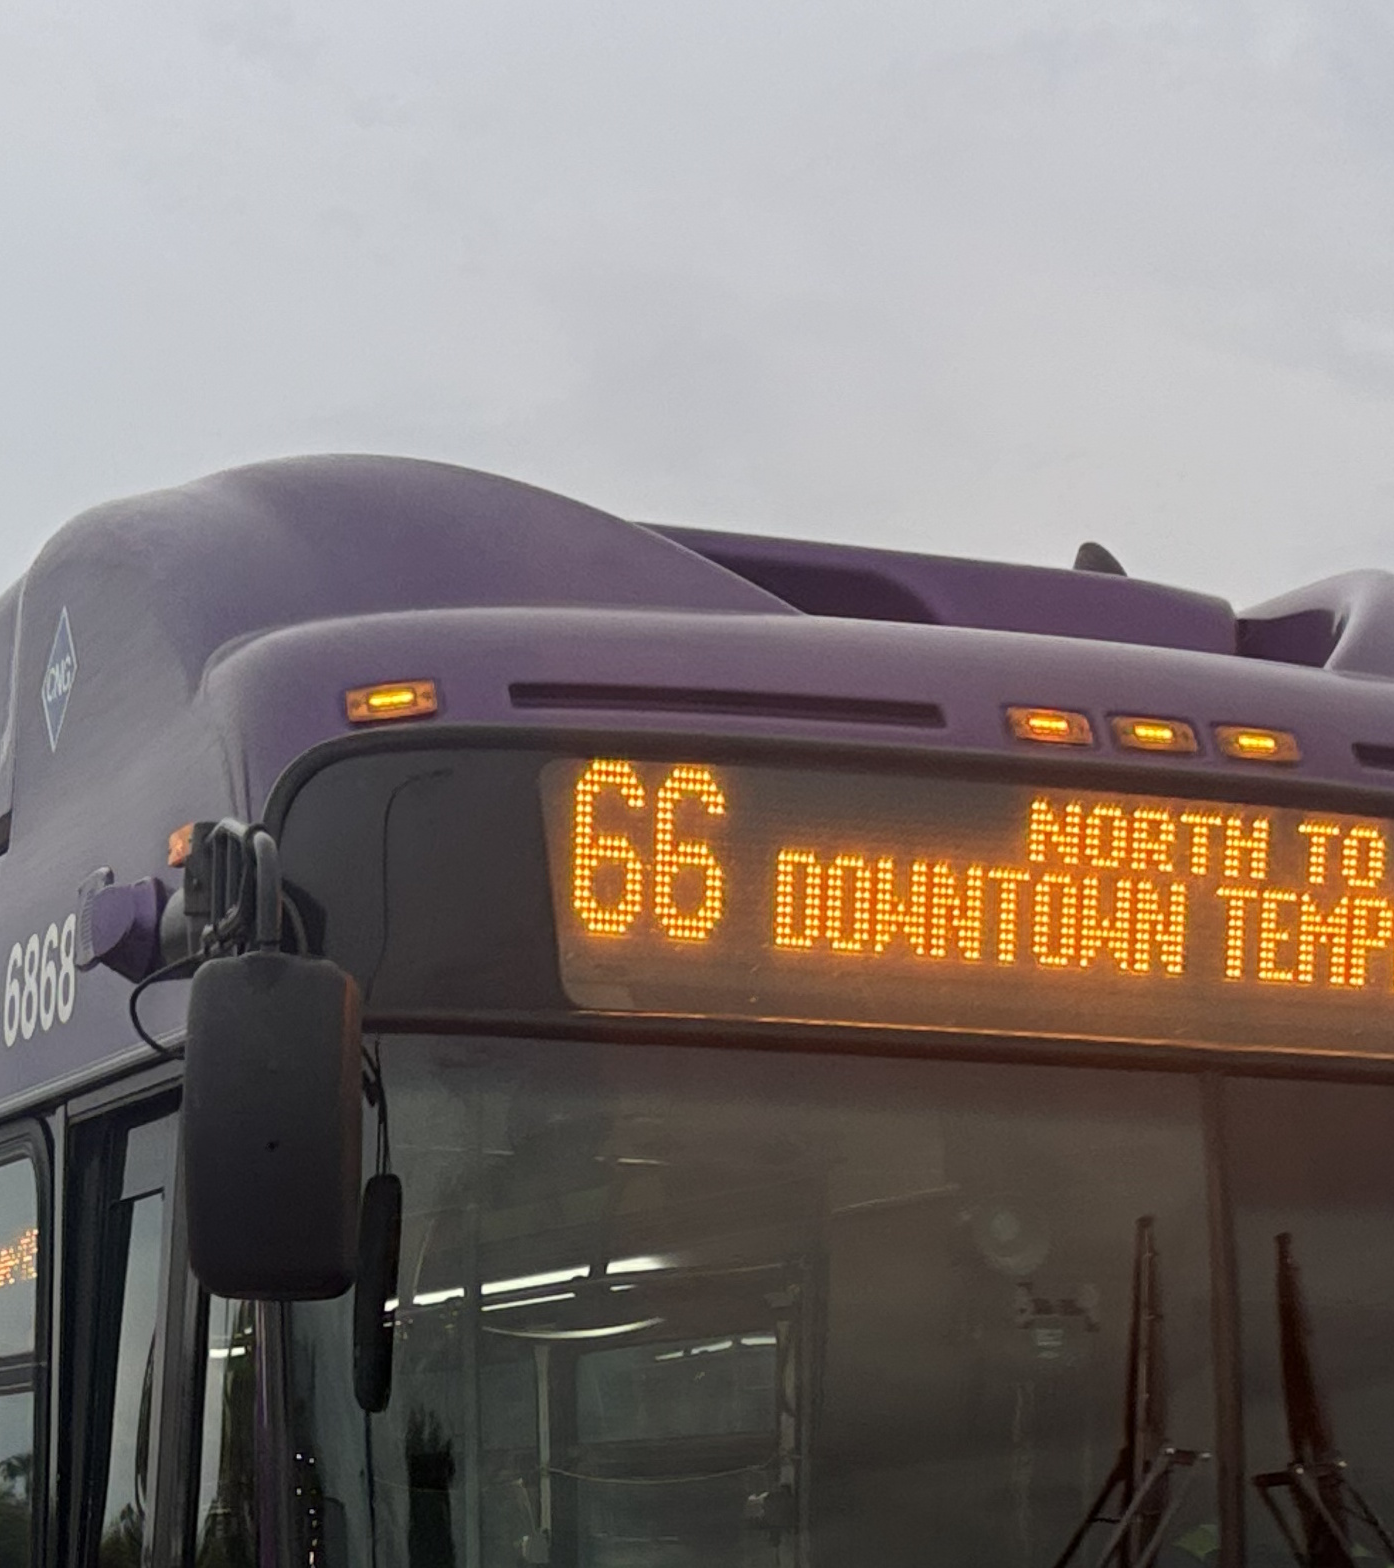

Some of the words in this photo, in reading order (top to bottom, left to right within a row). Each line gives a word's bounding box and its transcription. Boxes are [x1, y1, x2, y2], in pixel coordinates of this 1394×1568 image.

[46, 655, 72, 702] CNG
[571, 759, 727, 942] 66
[1025, 797, 1271, 880] NORTH
[1298, 821, 1388, 888] TO
[772, 848, 1188, 976] DOWNTOWN
[3, 913, 77, 1048] 6868
